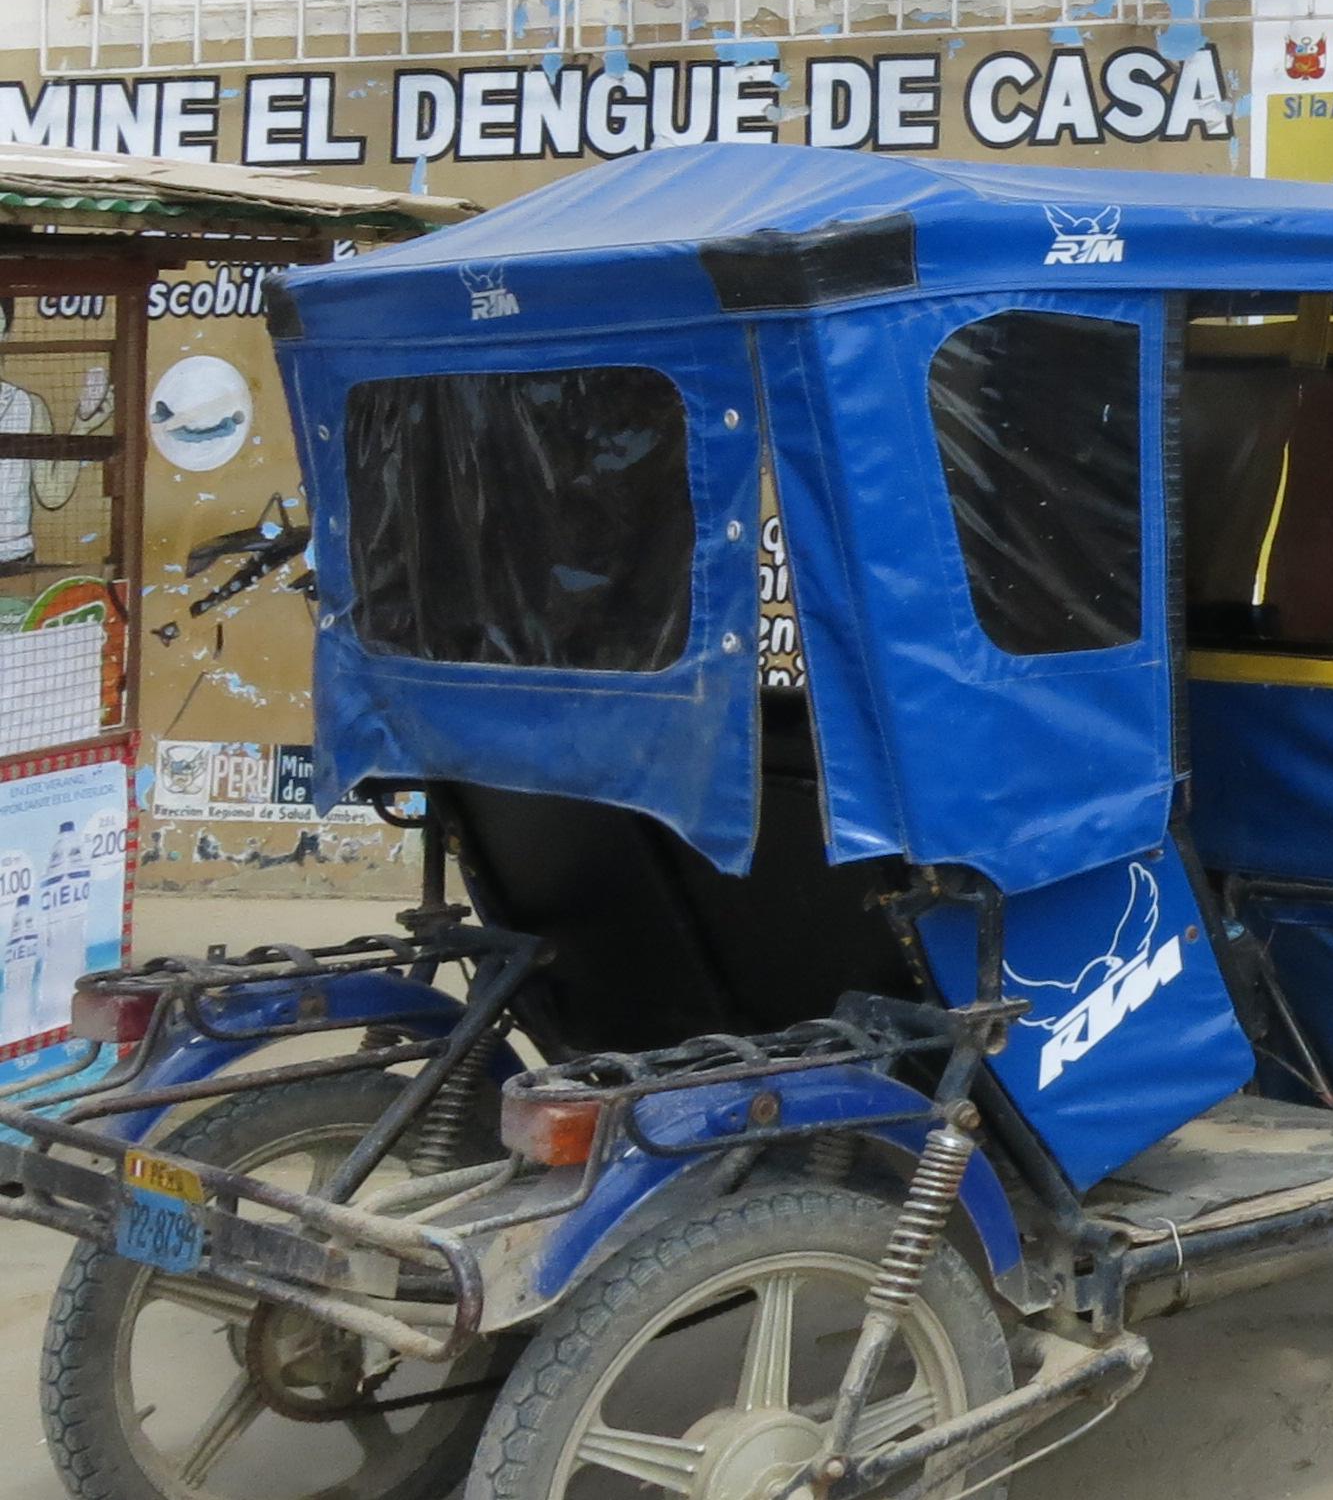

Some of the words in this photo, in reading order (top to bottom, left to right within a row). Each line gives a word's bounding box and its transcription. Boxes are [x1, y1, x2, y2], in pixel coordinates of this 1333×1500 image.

[241, 72, 366, 165] EL
[391, 57, 781, 164] DENGUE
[805, 51, 941, 151] DE
[964, 46, 1235, 150] CASA
[1283, 94, 1303, 120] Si
[1309, 95, 1328, 119] la
[146, 266, 270, 319] scobil
[282, 783, 306, 803] de
[258, 803, 274, 819] de
[279, 803, 312, 821] Salud
[325, 807, 367, 824] umbes
